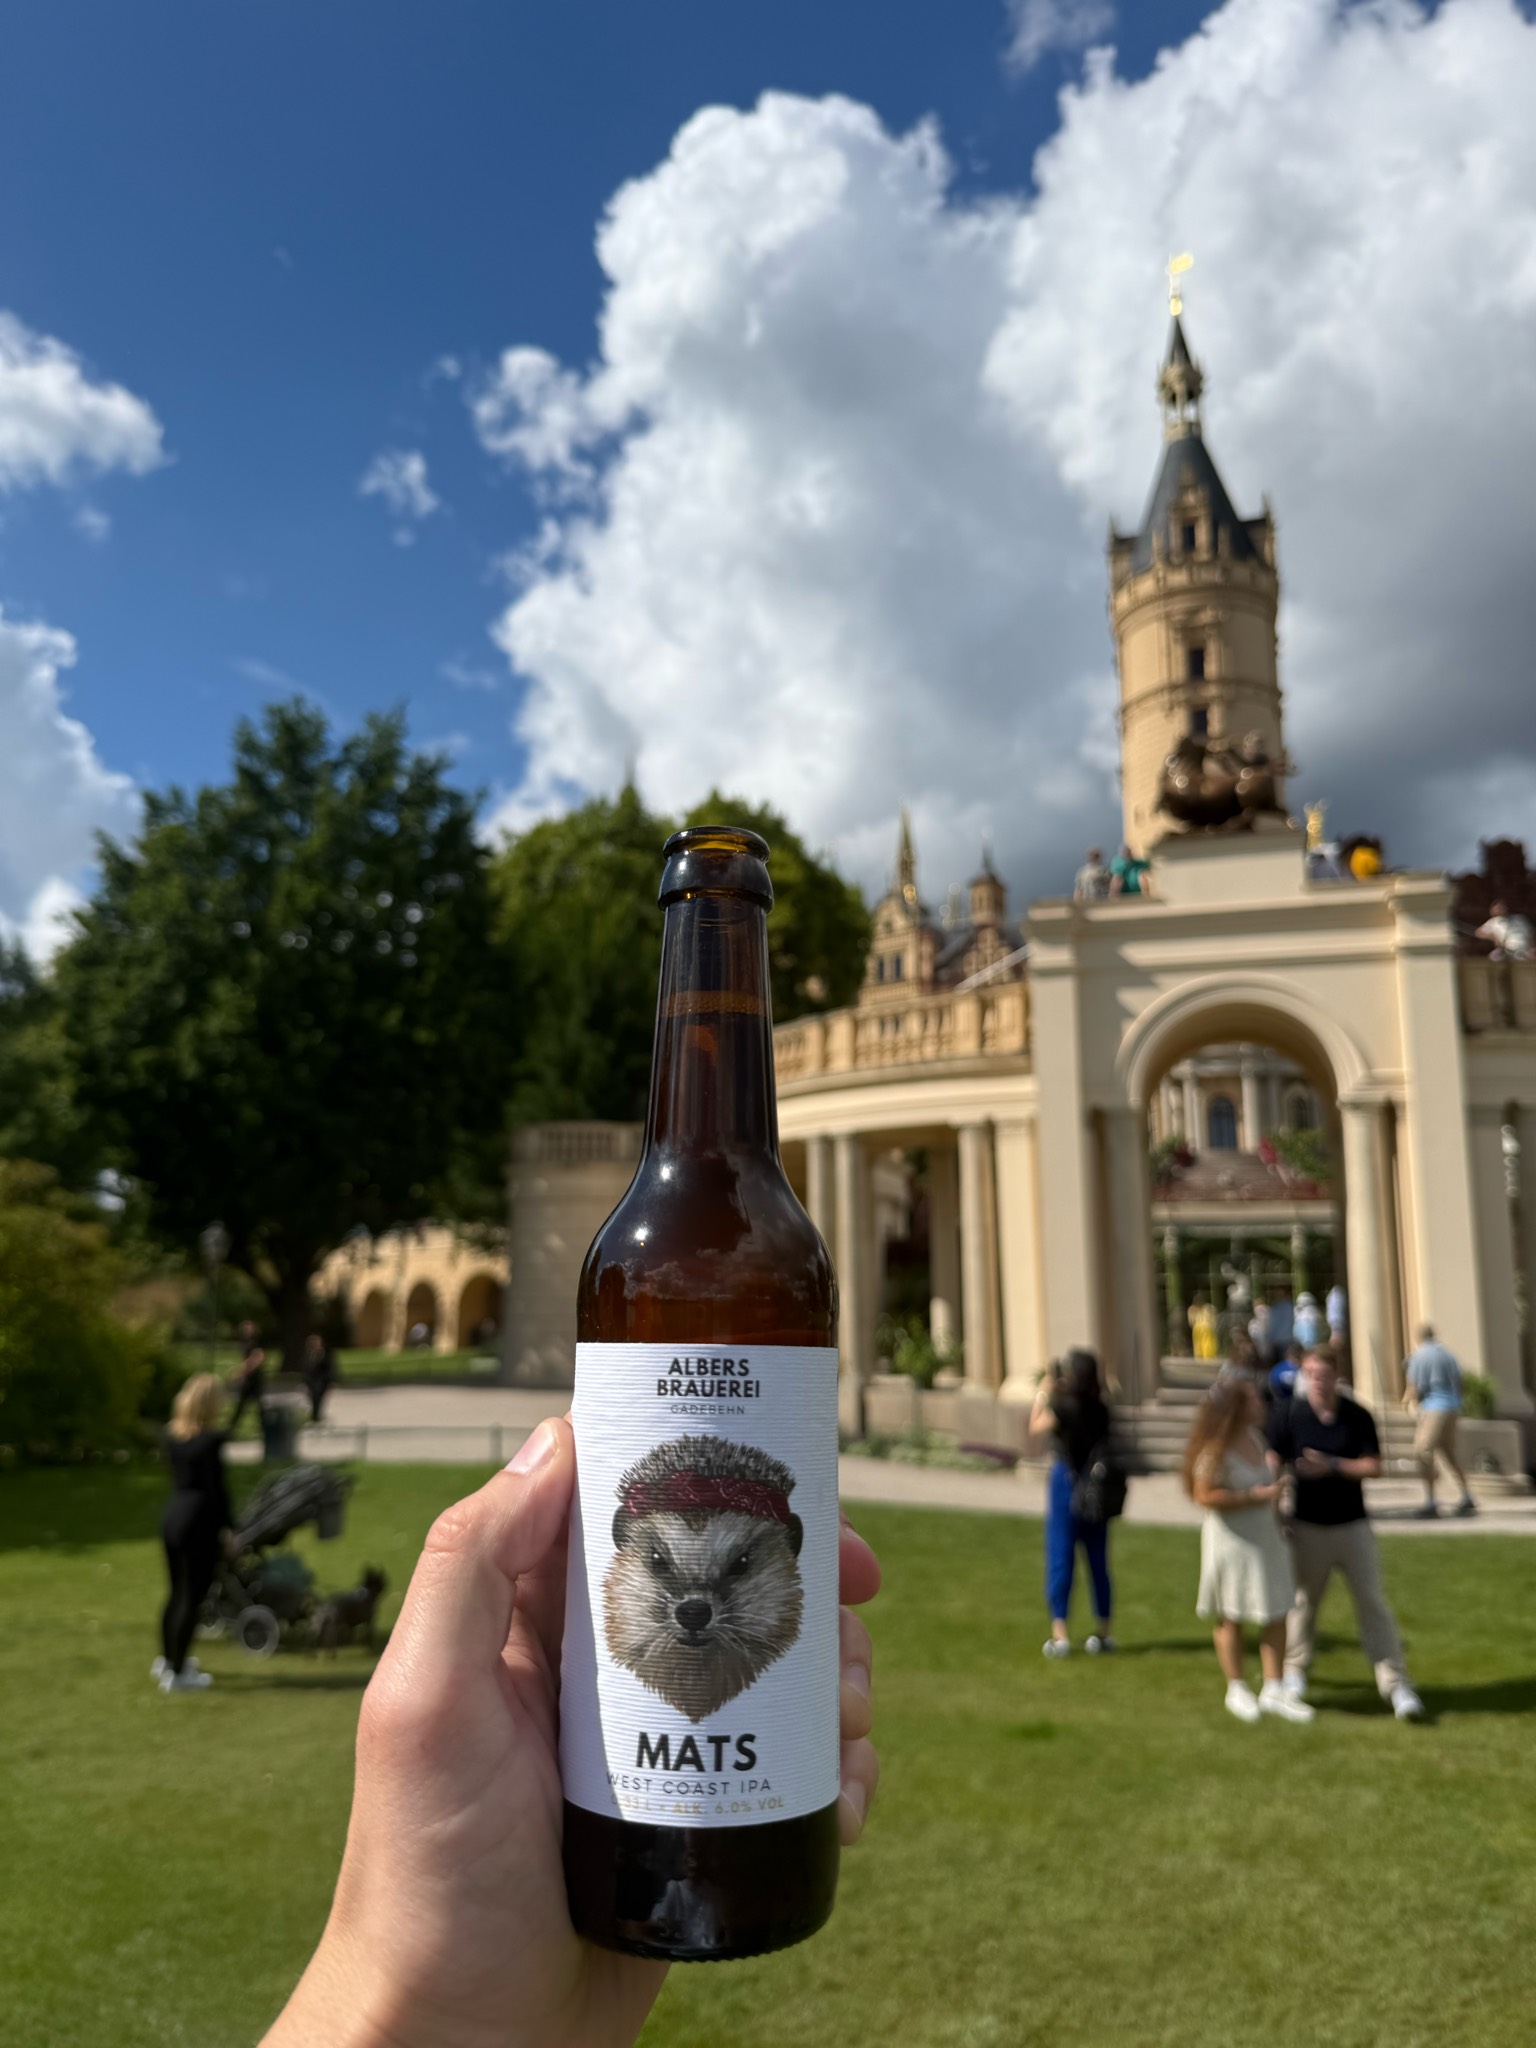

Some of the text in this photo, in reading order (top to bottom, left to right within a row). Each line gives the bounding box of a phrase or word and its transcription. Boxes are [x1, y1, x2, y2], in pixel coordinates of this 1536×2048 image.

[668, 1358, 750, 1376] ALBERS
[657, 1379, 760, 1398] BRAUEREI
[671, 1404, 745, 1415] GADEBEHN
[636, 1731, 757, 1772] MATS
[606, 1771, 771, 1796] WEST COAST IPA
[758, 1796, 784, 1811] VOL
